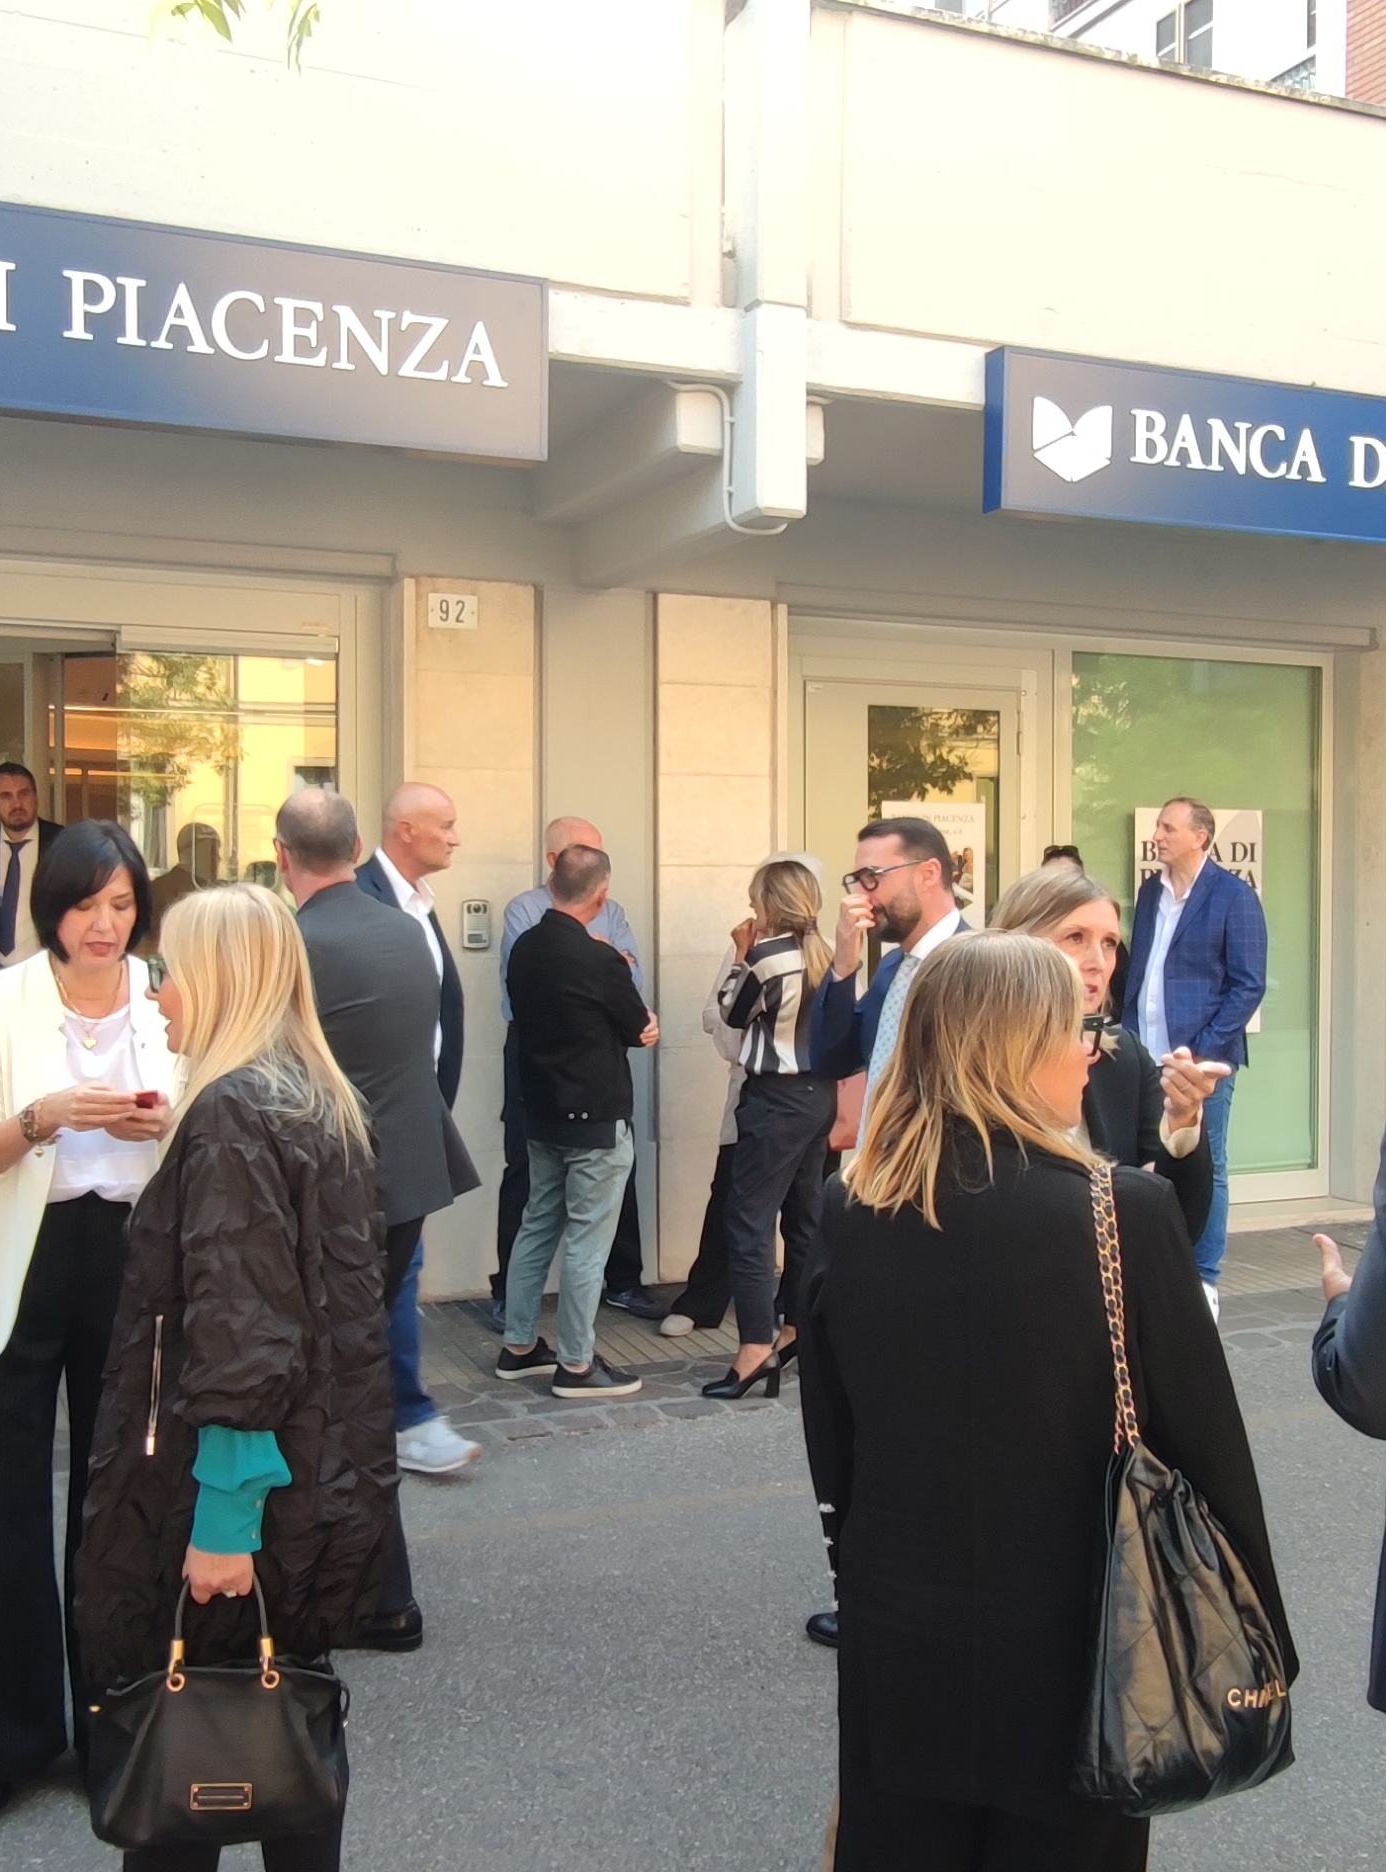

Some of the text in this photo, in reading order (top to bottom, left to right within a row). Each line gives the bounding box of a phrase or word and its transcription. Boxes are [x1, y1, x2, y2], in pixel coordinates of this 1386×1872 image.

[62, 270, 511, 389] PIACENZA
[1128, 408, 1327, 483] BANCA
[439, 599, 466, 623] 92
[934, 814, 975, 824] PIACENZA
[1230, 842, 1257, 863] DI
